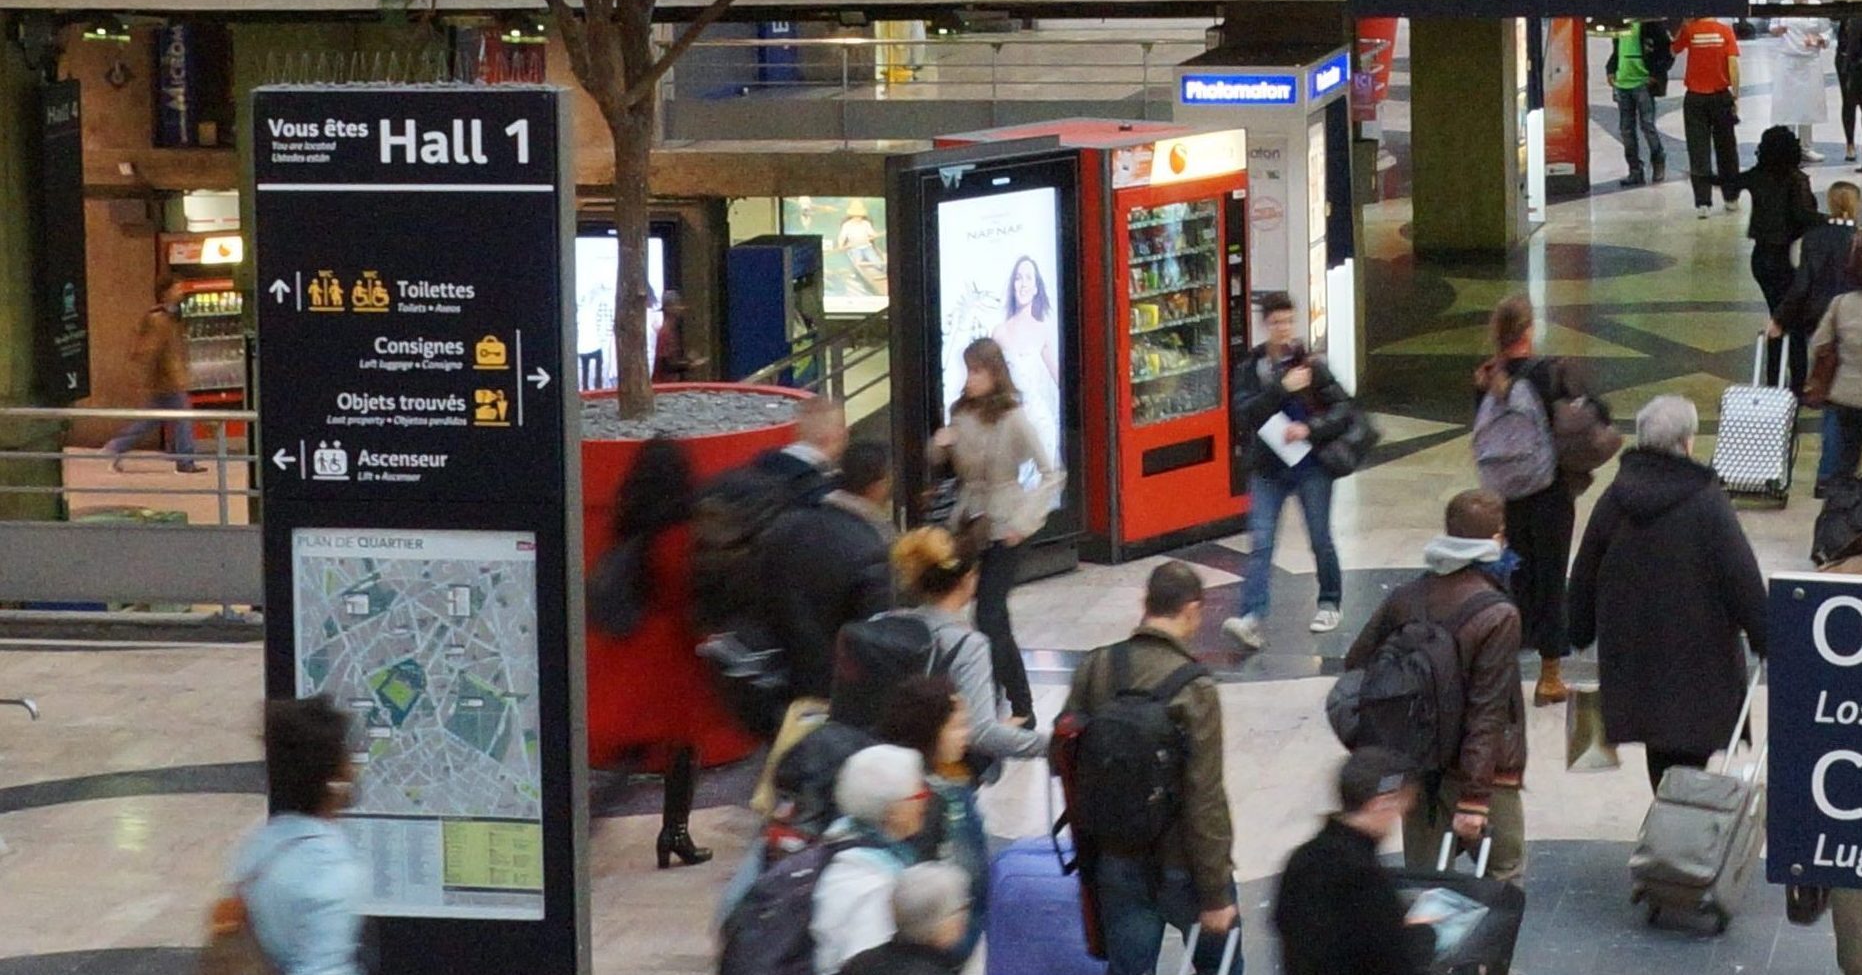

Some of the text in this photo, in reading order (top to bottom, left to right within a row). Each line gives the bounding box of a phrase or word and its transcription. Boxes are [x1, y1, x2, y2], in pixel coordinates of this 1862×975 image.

[1186, 81, 1291, 99] Photomaton
[268, 118, 529, 164] Vous êtes Hall 1
[397, 280, 475, 299] Toilettes
[374, 336, 465, 358] Consignes
[337, 392, 466, 414] Objets trouvés
[357, 449, 448, 467] Ascenseur
[297, 535, 424, 551] PLAN DE QUARTIER
